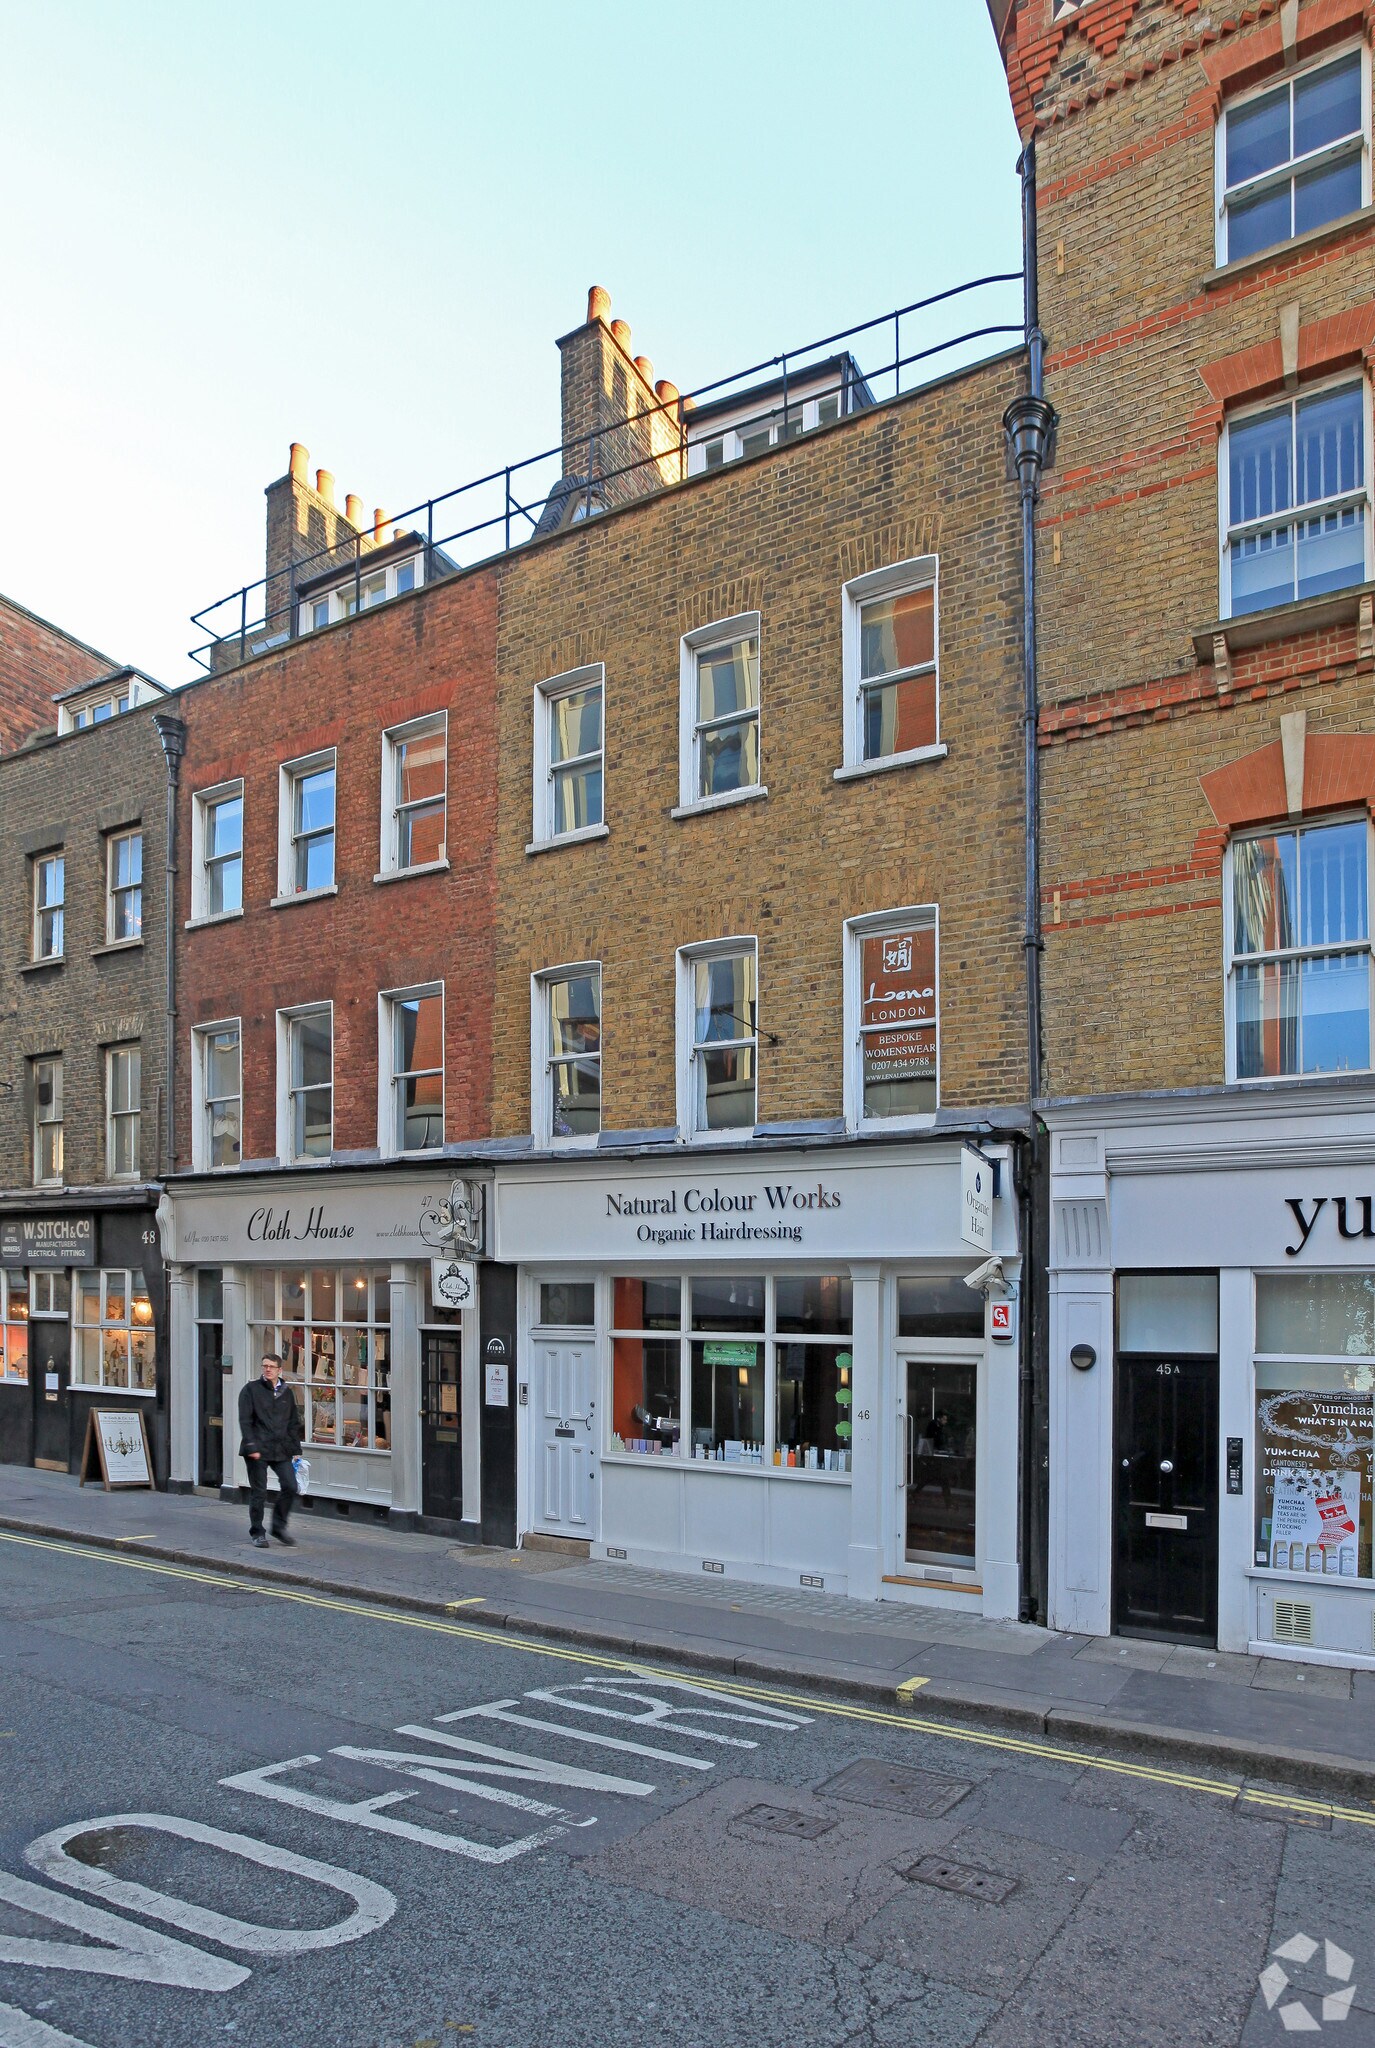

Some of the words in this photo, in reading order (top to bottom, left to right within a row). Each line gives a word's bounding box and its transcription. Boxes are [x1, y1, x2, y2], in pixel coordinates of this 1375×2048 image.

[864, 982, 934, 1005] Lena
[871, 1006, 926, 1022] LONDON
[879, 1032, 922, 1045] BESPOKE
[865, 1043, 936, 1058] WOMENSWEAR
[871, 1060, 890, 1071] 0207
[892, 1058, 908, 1068] 434
[909, 1057, 930, 1067] 9788
[865, 1069, 936, 1081] WWW.LENALONDON.COM
[421, 1196, 433, 1208] 47
[605, 1190, 677, 1216] Natural
[683, 1188, 757, 1213] Colour
[763, 1183, 841, 1209] Works
[966, 1189, 989, 1217] Organic
[247, 1207, 291, 1241] Cloth
[294, 1205, 355, 1241] House
[971, 1216, 985, 1237] Hair
[1284, 1196, 1375, 1256] yu
[141, 1230, 156, 1244] 48
[636, 1223, 696, 1245] Organic
[701, 1220, 803, 1243] Hairdressing
[27, 1249, 57, 1257] ELECTRICAL
[60, 1249, 86, 1257] FITTINGS
[1156, 1364, 1171, 1375] 45
[1173, 1365, 1180, 1374] A
[1305, 1392, 1333, 1400] CURATORS
[857, 1410, 870, 1420] 46
[1312, 1403, 1374, 1417] yumchaa
[558, 1420, 570, 1429] 46
[1337, 1418, 1348, 1427] IN
[1350, 1419, 1357, 1427] A
[1270, 1458, 1307, 1468] (CANTONESE)
[0, 1812, 398, 2048] NO
[217, 1668, 815, 1864] ENTRY
